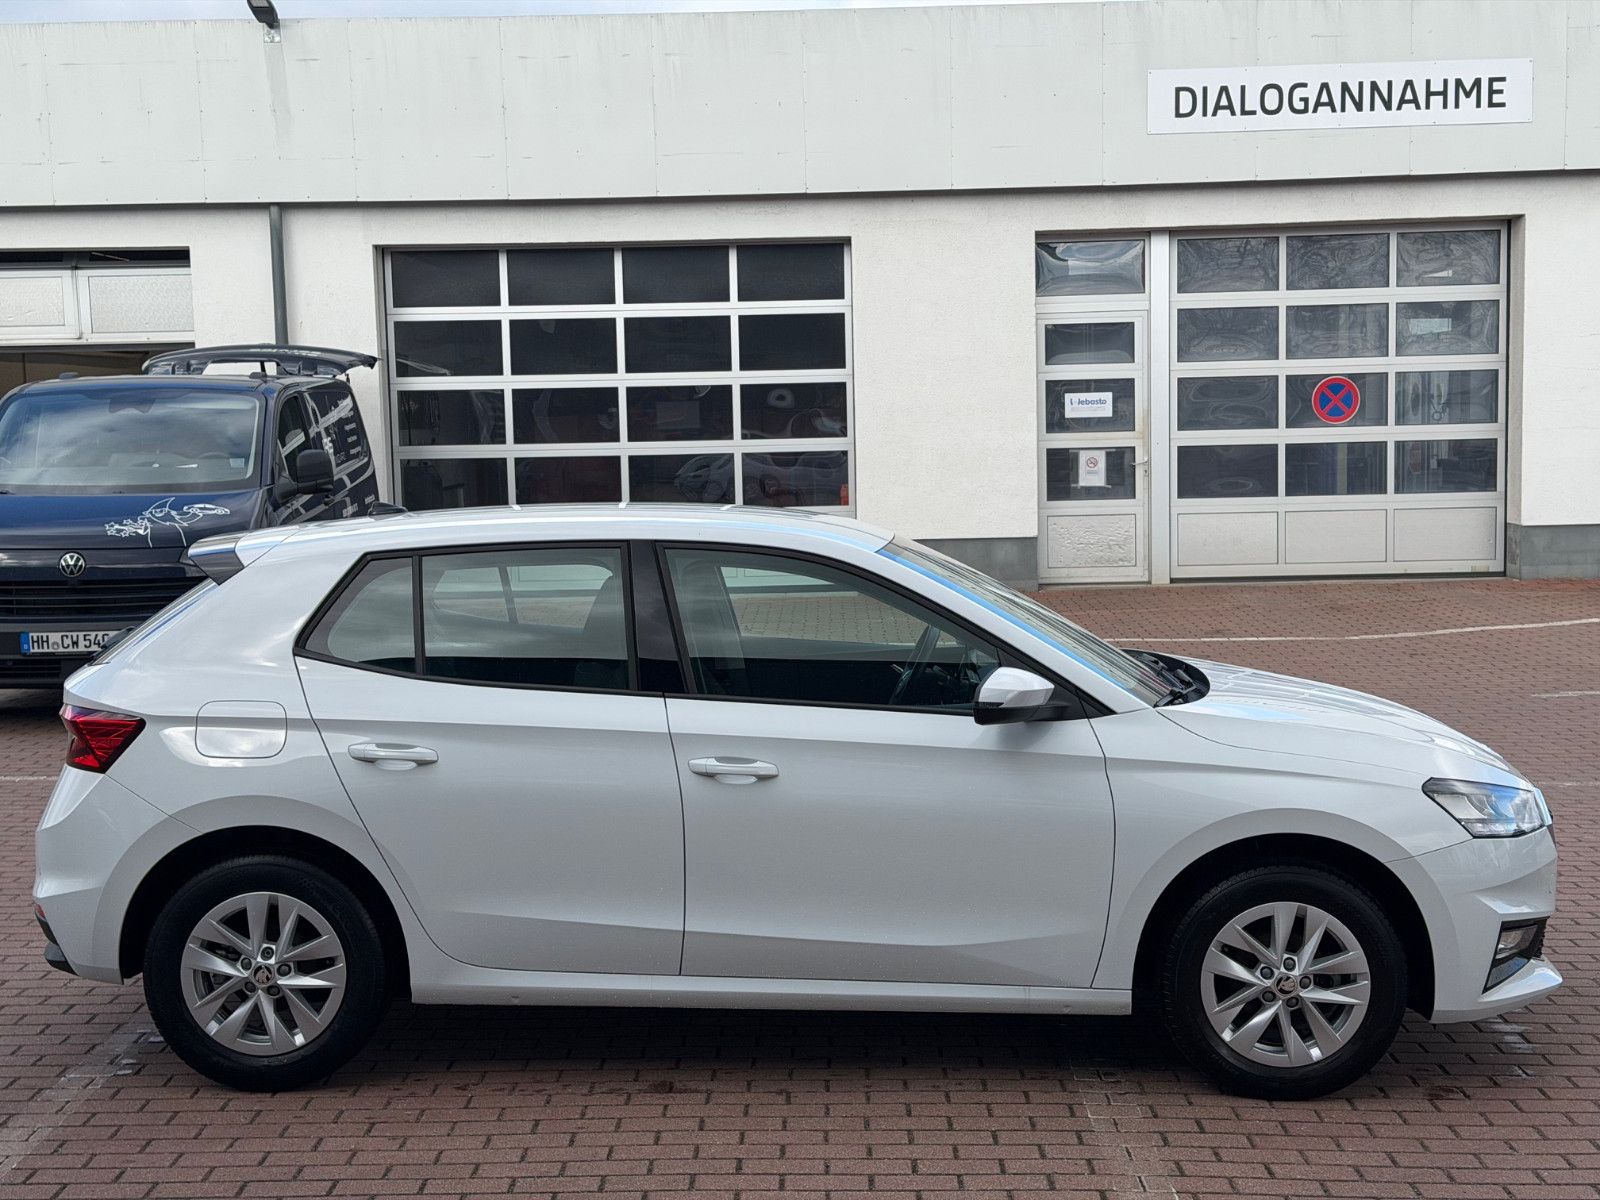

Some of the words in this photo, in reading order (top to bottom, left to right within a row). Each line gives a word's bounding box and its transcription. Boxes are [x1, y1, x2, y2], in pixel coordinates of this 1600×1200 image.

[1174, 76, 1508, 118] DIALOGANNAHME
[30, 634, 50, 650] HH
[60, 634, 80, 650] CW
